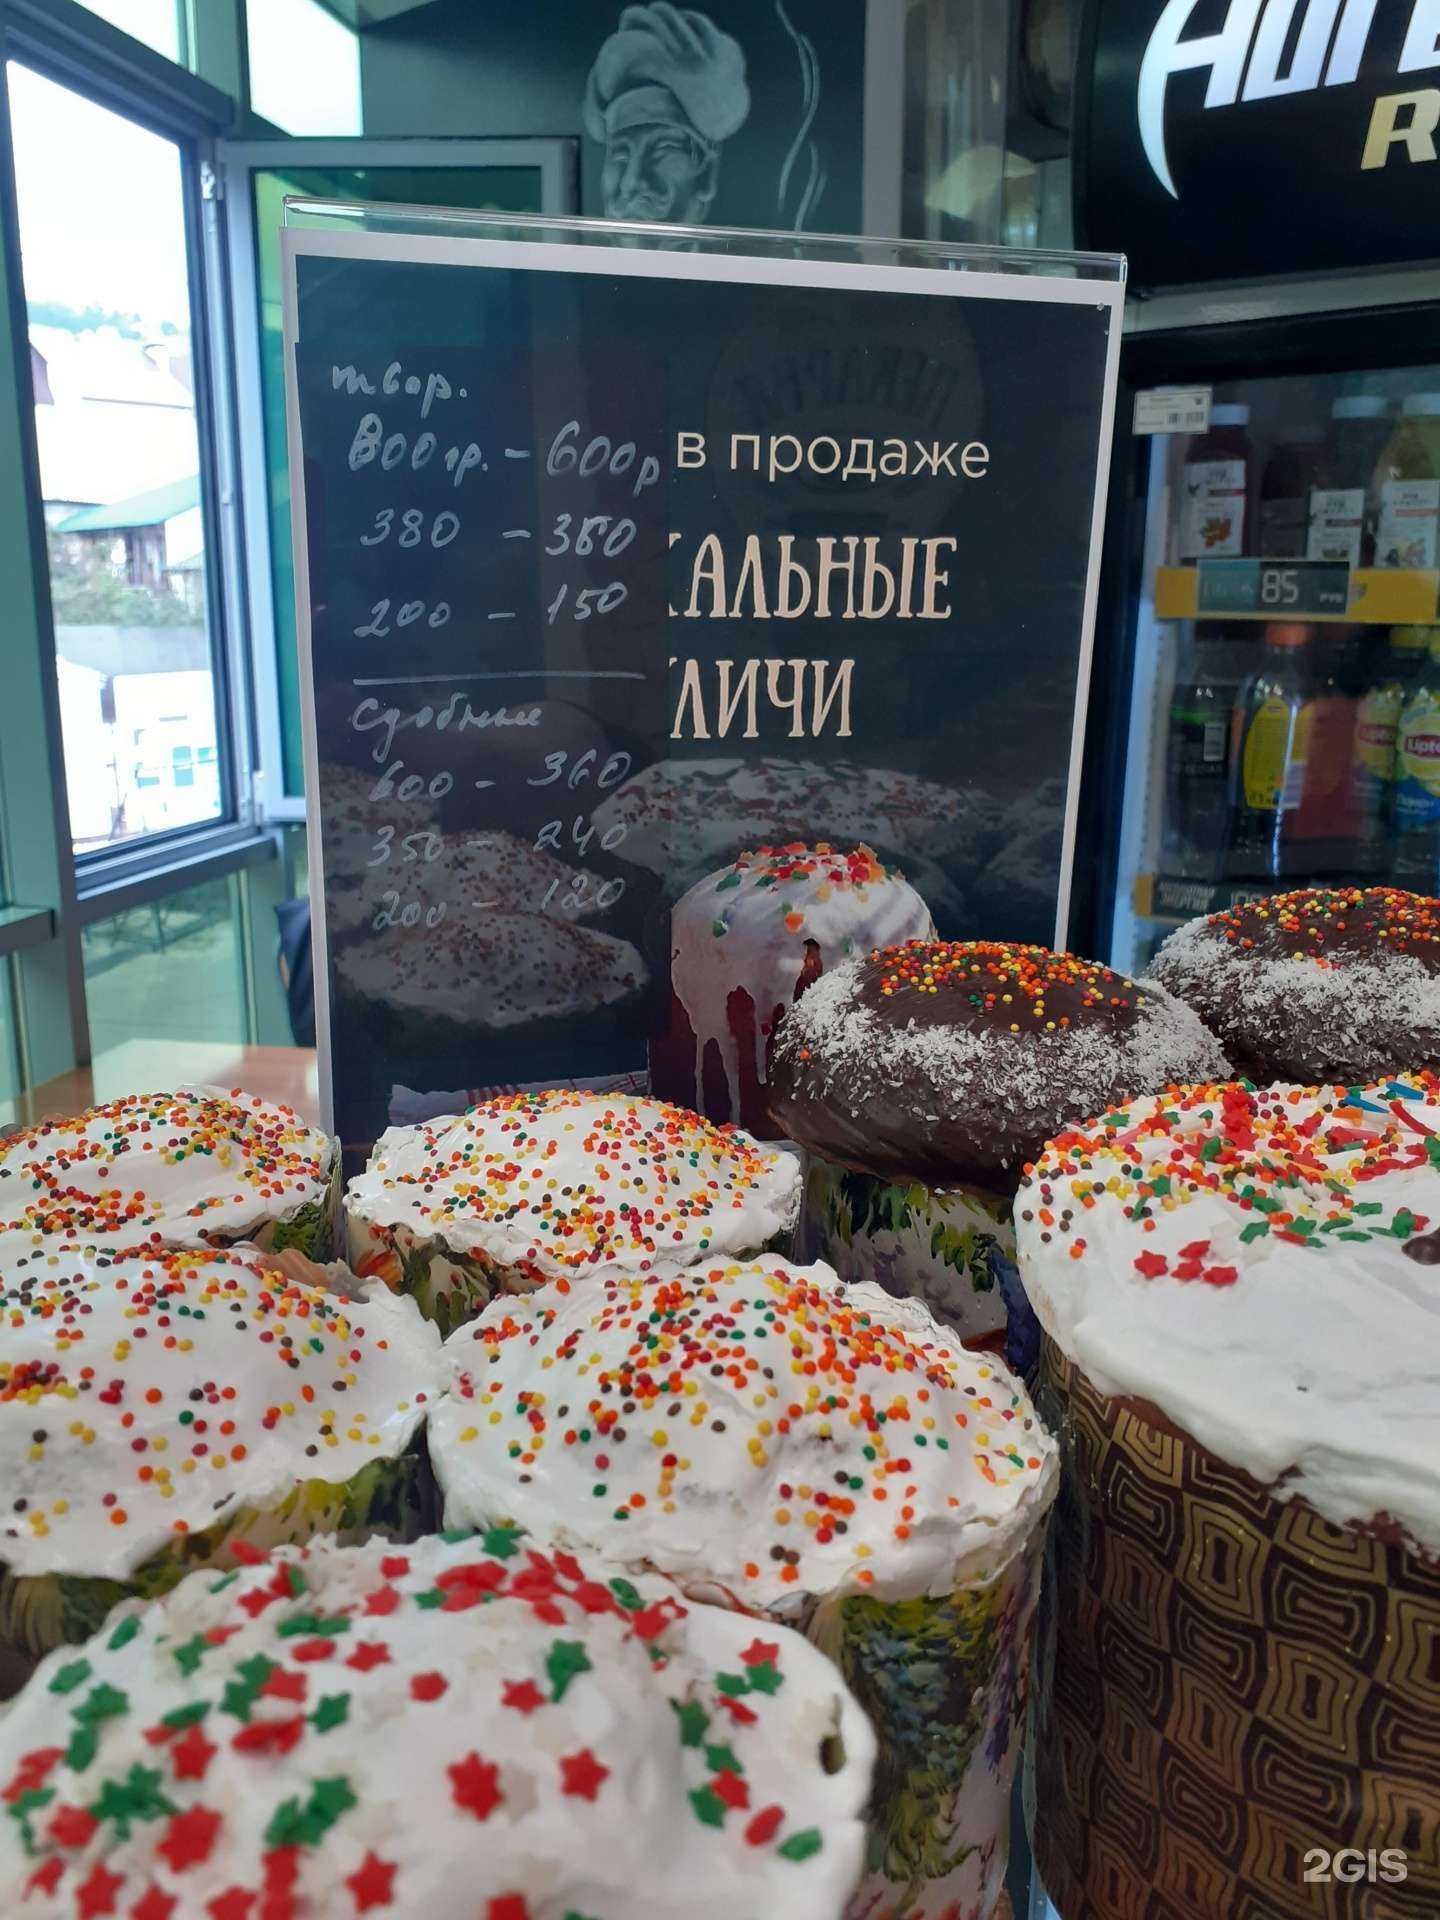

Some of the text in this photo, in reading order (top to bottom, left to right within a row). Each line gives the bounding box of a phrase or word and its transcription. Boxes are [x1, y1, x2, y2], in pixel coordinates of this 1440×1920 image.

[676, 431, 990, 482] в продаже
[360, 508, 461, 548] 380
[668, 532, 958, 620] АЛЬНЫЕ
[1260, 569, 1299, 604] 85
[353, 598, 450, 637] 200
[546, 582, 629, 626] 150
[668, 656, 856, 740] ЛИЧИ
[368, 760, 454, 801] 600
[526, 748, 632, 789] 360
[367, 825, 446, 868] 350
[541, 873, 626, 911] 120
